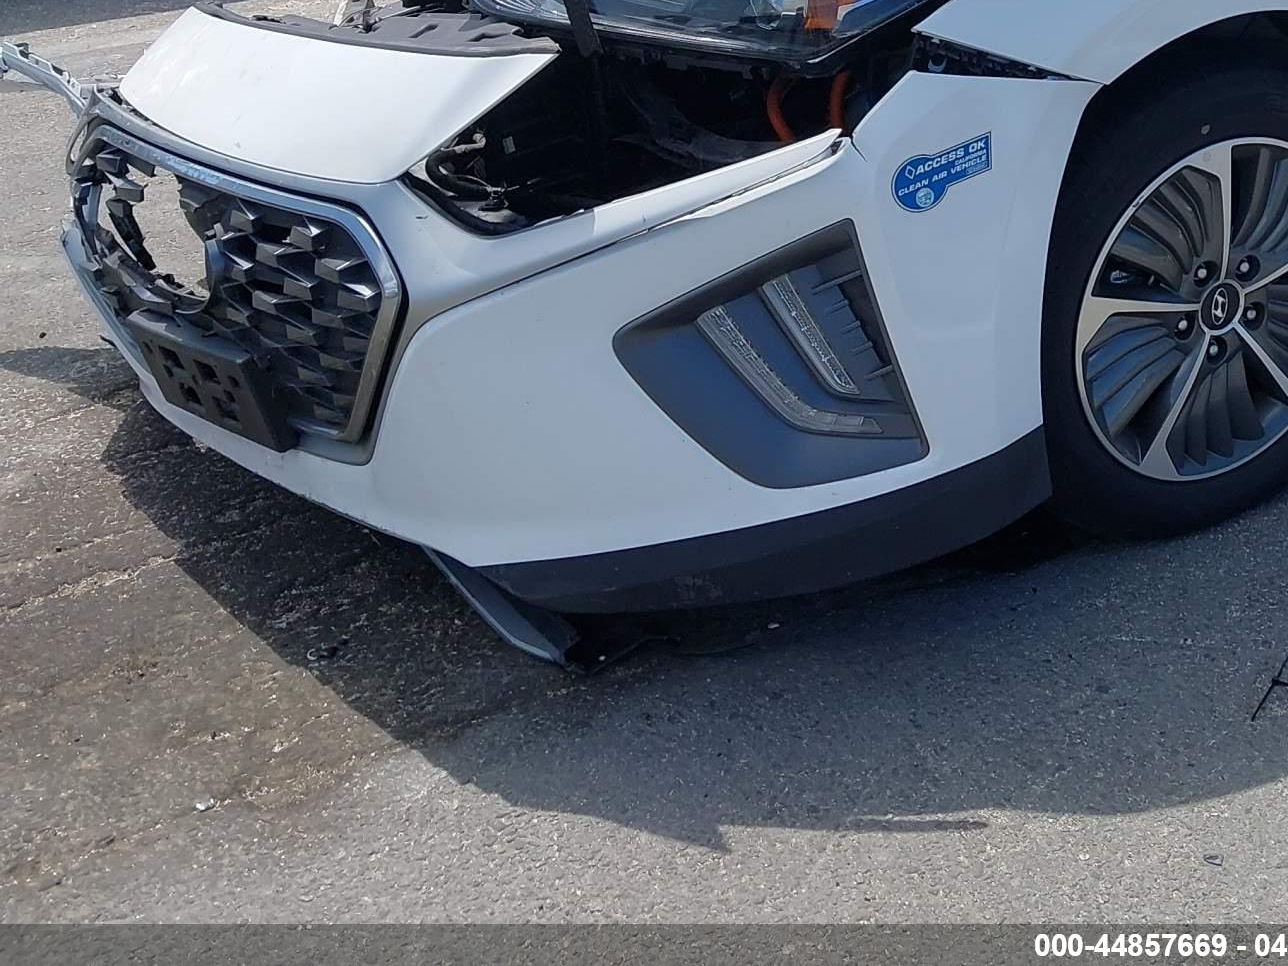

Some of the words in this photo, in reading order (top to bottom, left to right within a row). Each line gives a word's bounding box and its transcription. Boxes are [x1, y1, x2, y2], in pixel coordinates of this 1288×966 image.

[898, 178, 929, 197] CLEAN
[932, 171, 948, 183] AIR
[951, 155, 988, 175] VEHICLE
[915, 147, 965, 176] ACCESS
[968, 139, 986, 154] OK
[954, 149, 987, 166] CALIFORNIA
